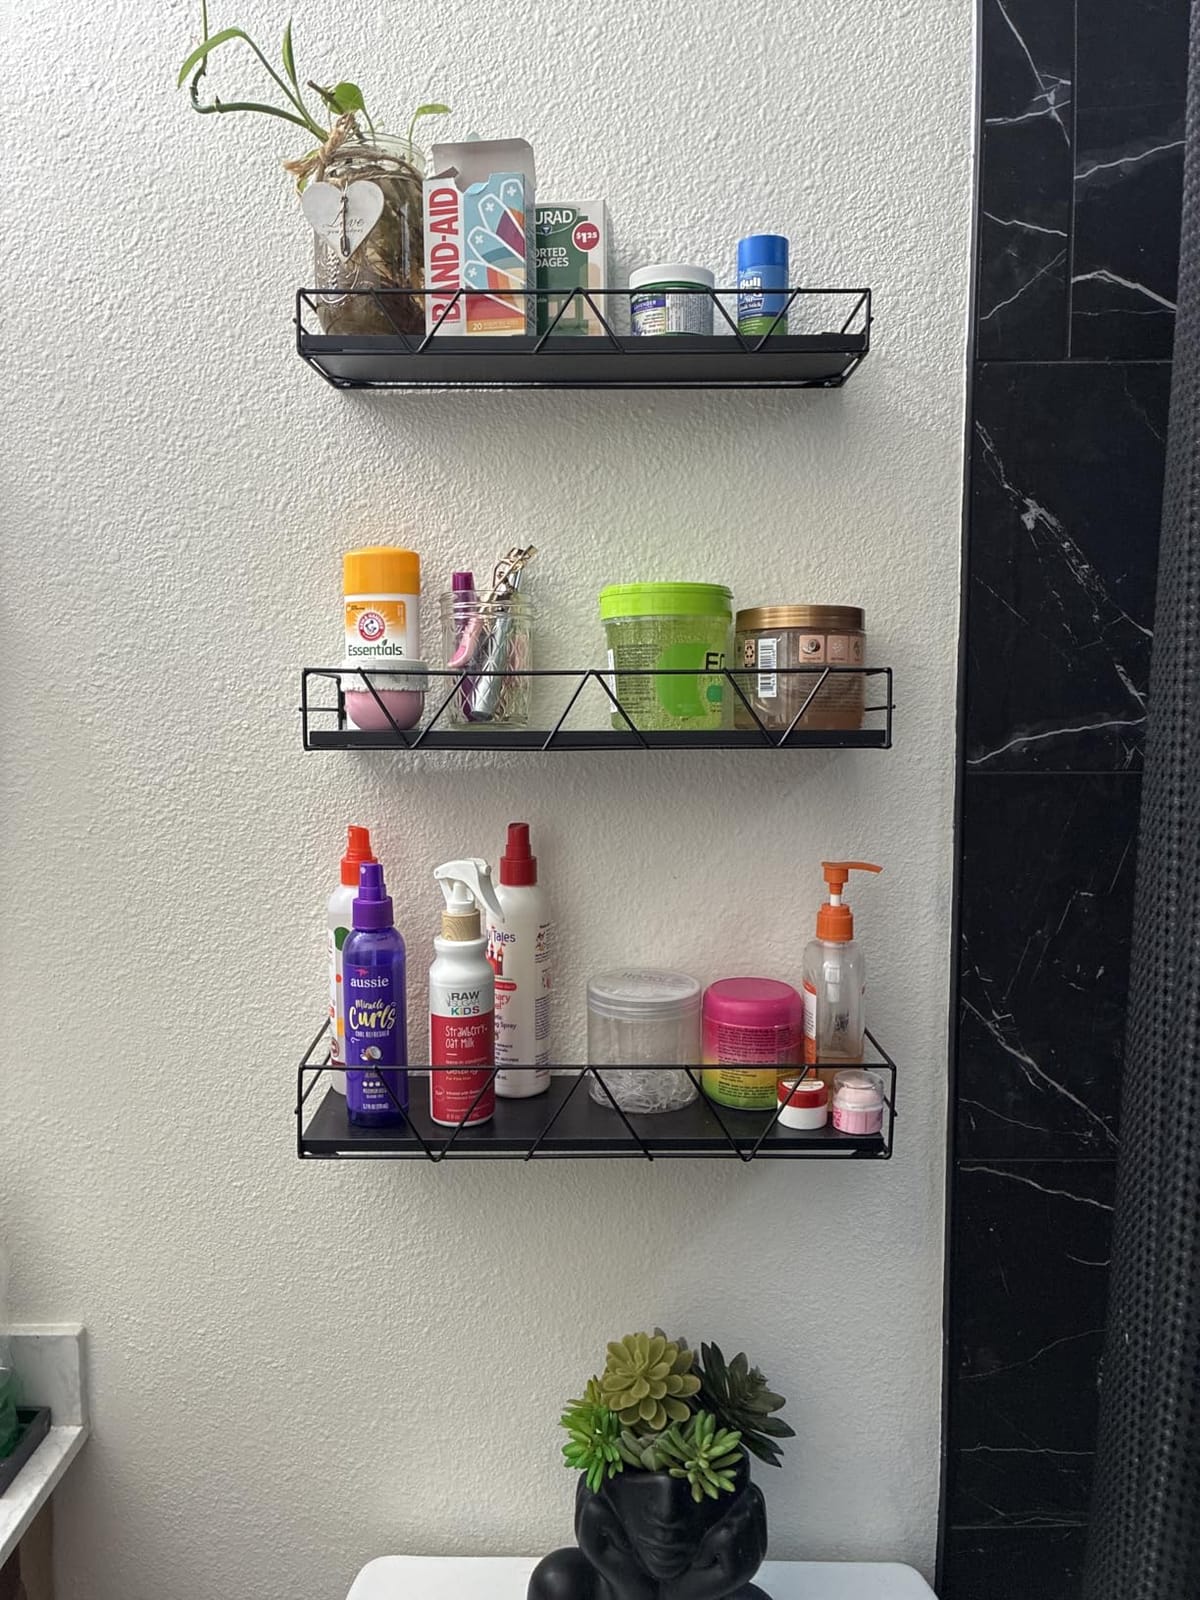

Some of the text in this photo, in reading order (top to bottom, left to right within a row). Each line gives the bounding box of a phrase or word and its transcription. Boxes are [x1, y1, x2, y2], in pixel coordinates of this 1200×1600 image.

[429, 188, 461, 321] BAND-AID
[472, 322, 482, 331] 20
[348, 642, 403, 657] Essentials
[494, 930, 516, 942] Tales
[350, 976, 389, 988] aussie
[451, 990, 480, 1001] RAW
[355, 999, 384, 1010] Miracle
[451, 1005, 480, 1016] KIDS
[349, 1004, 397, 1030] Curls
[445, 1038, 458, 1049] Oat
